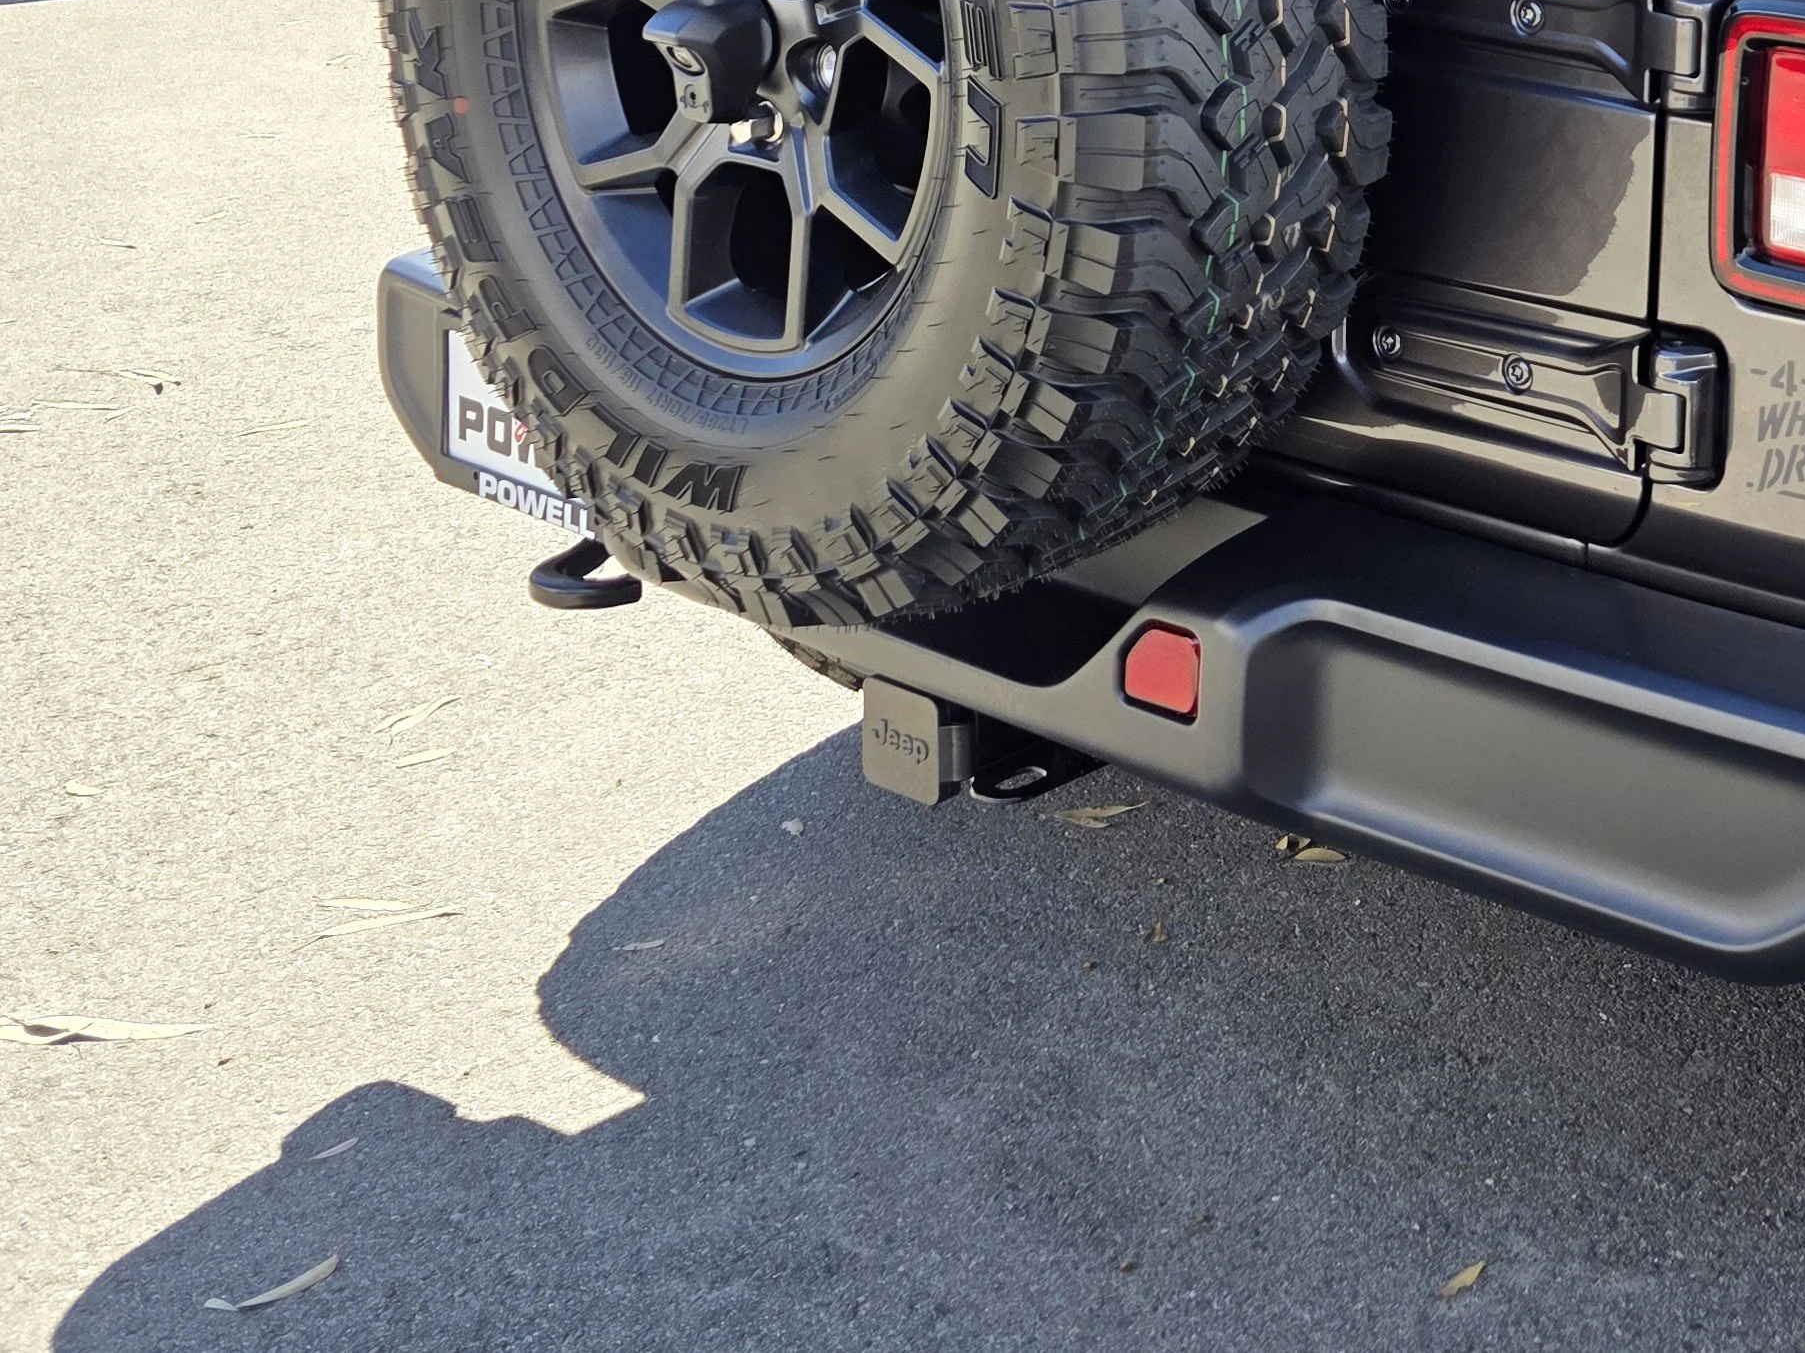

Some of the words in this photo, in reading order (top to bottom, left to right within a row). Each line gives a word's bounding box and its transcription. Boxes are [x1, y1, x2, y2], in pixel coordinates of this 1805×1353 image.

[404, 7, 750, 512] WILDPEAK
[1770, 360, 1798, 397] 4
[478, 471, 595, 540] POWELL
[872, 718, 929, 764] Jeep
